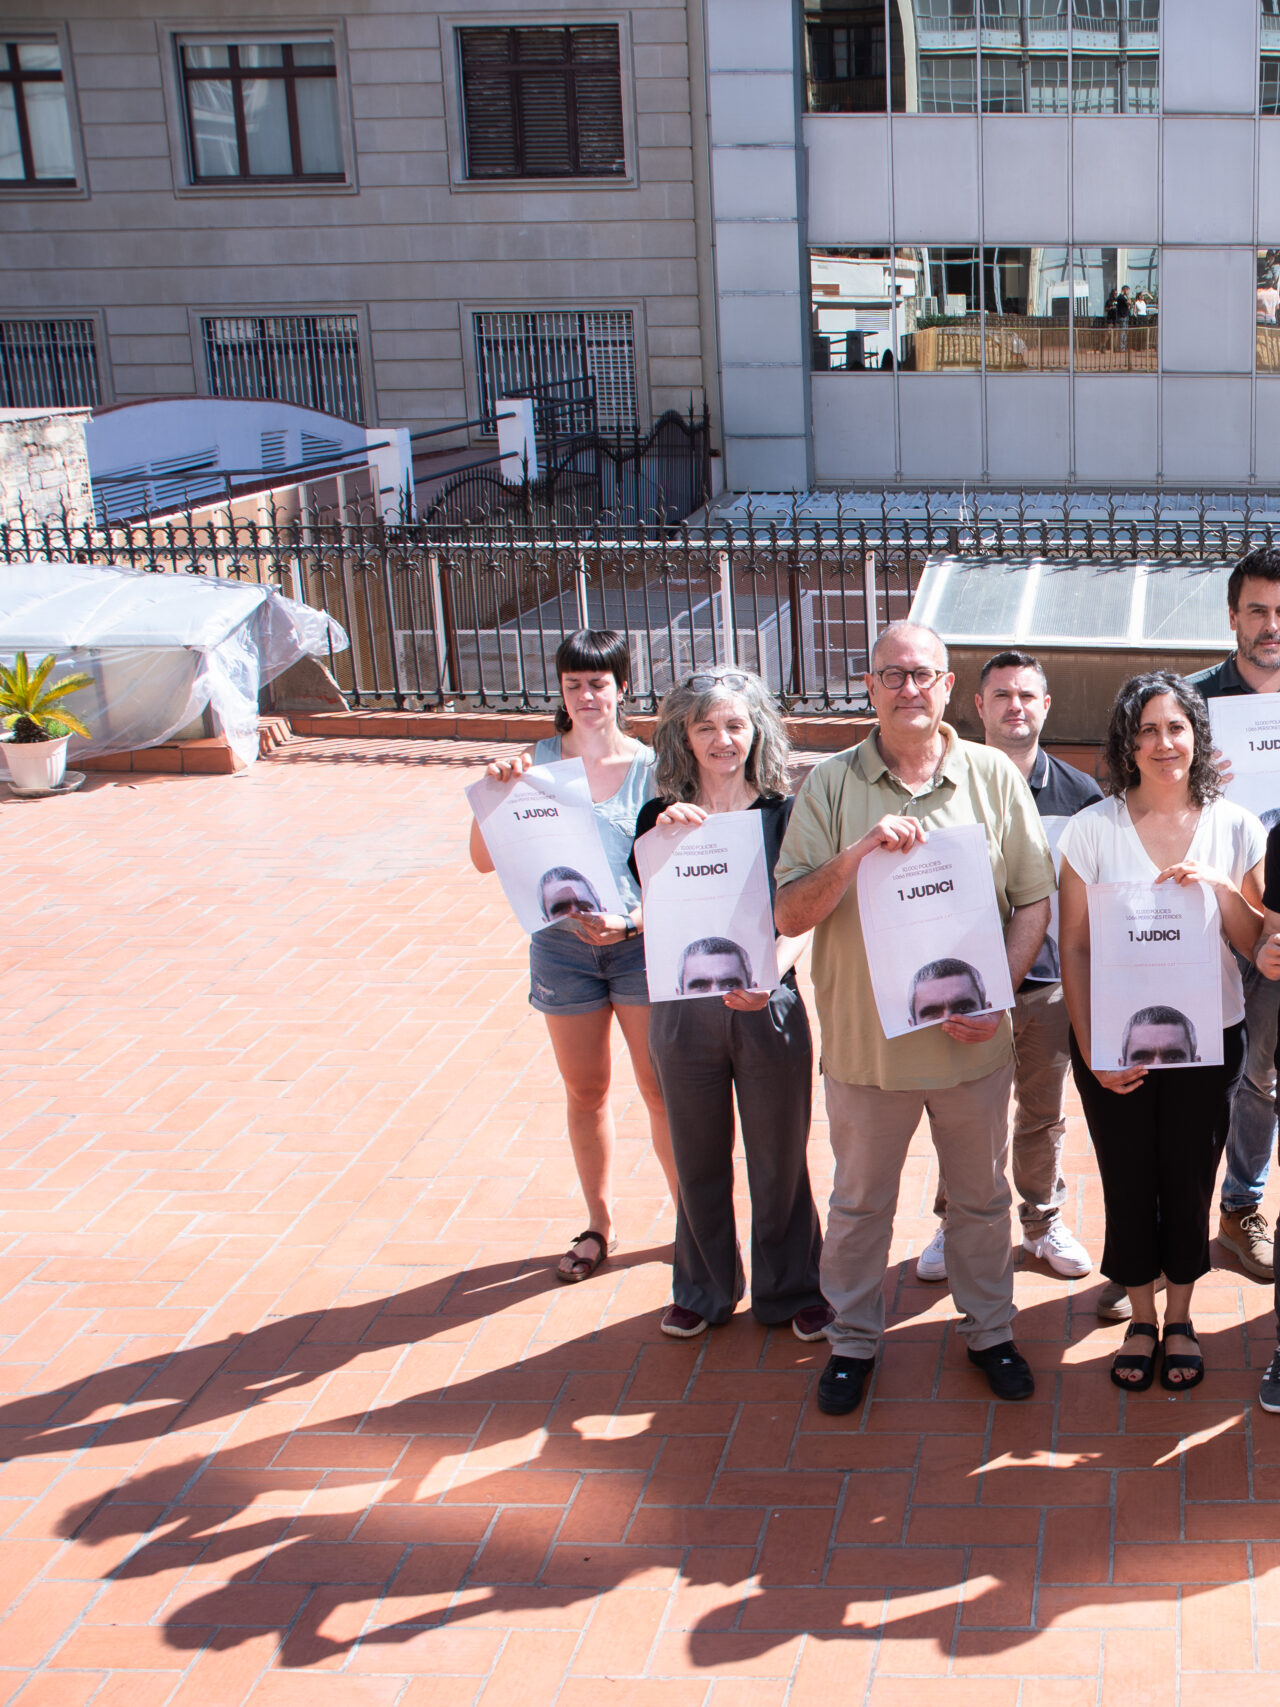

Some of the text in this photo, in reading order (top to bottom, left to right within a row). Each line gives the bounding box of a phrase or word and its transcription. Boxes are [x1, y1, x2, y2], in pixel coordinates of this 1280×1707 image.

[1248, 741, 1254, 751] 1
[513, 807, 559, 821] 1 JUDICI
[675, 862, 729, 877] 1 JUDICI
[897, 879, 954, 901] 1 JUDICI
[1128, 929, 1181, 942] 1 JUDICI
